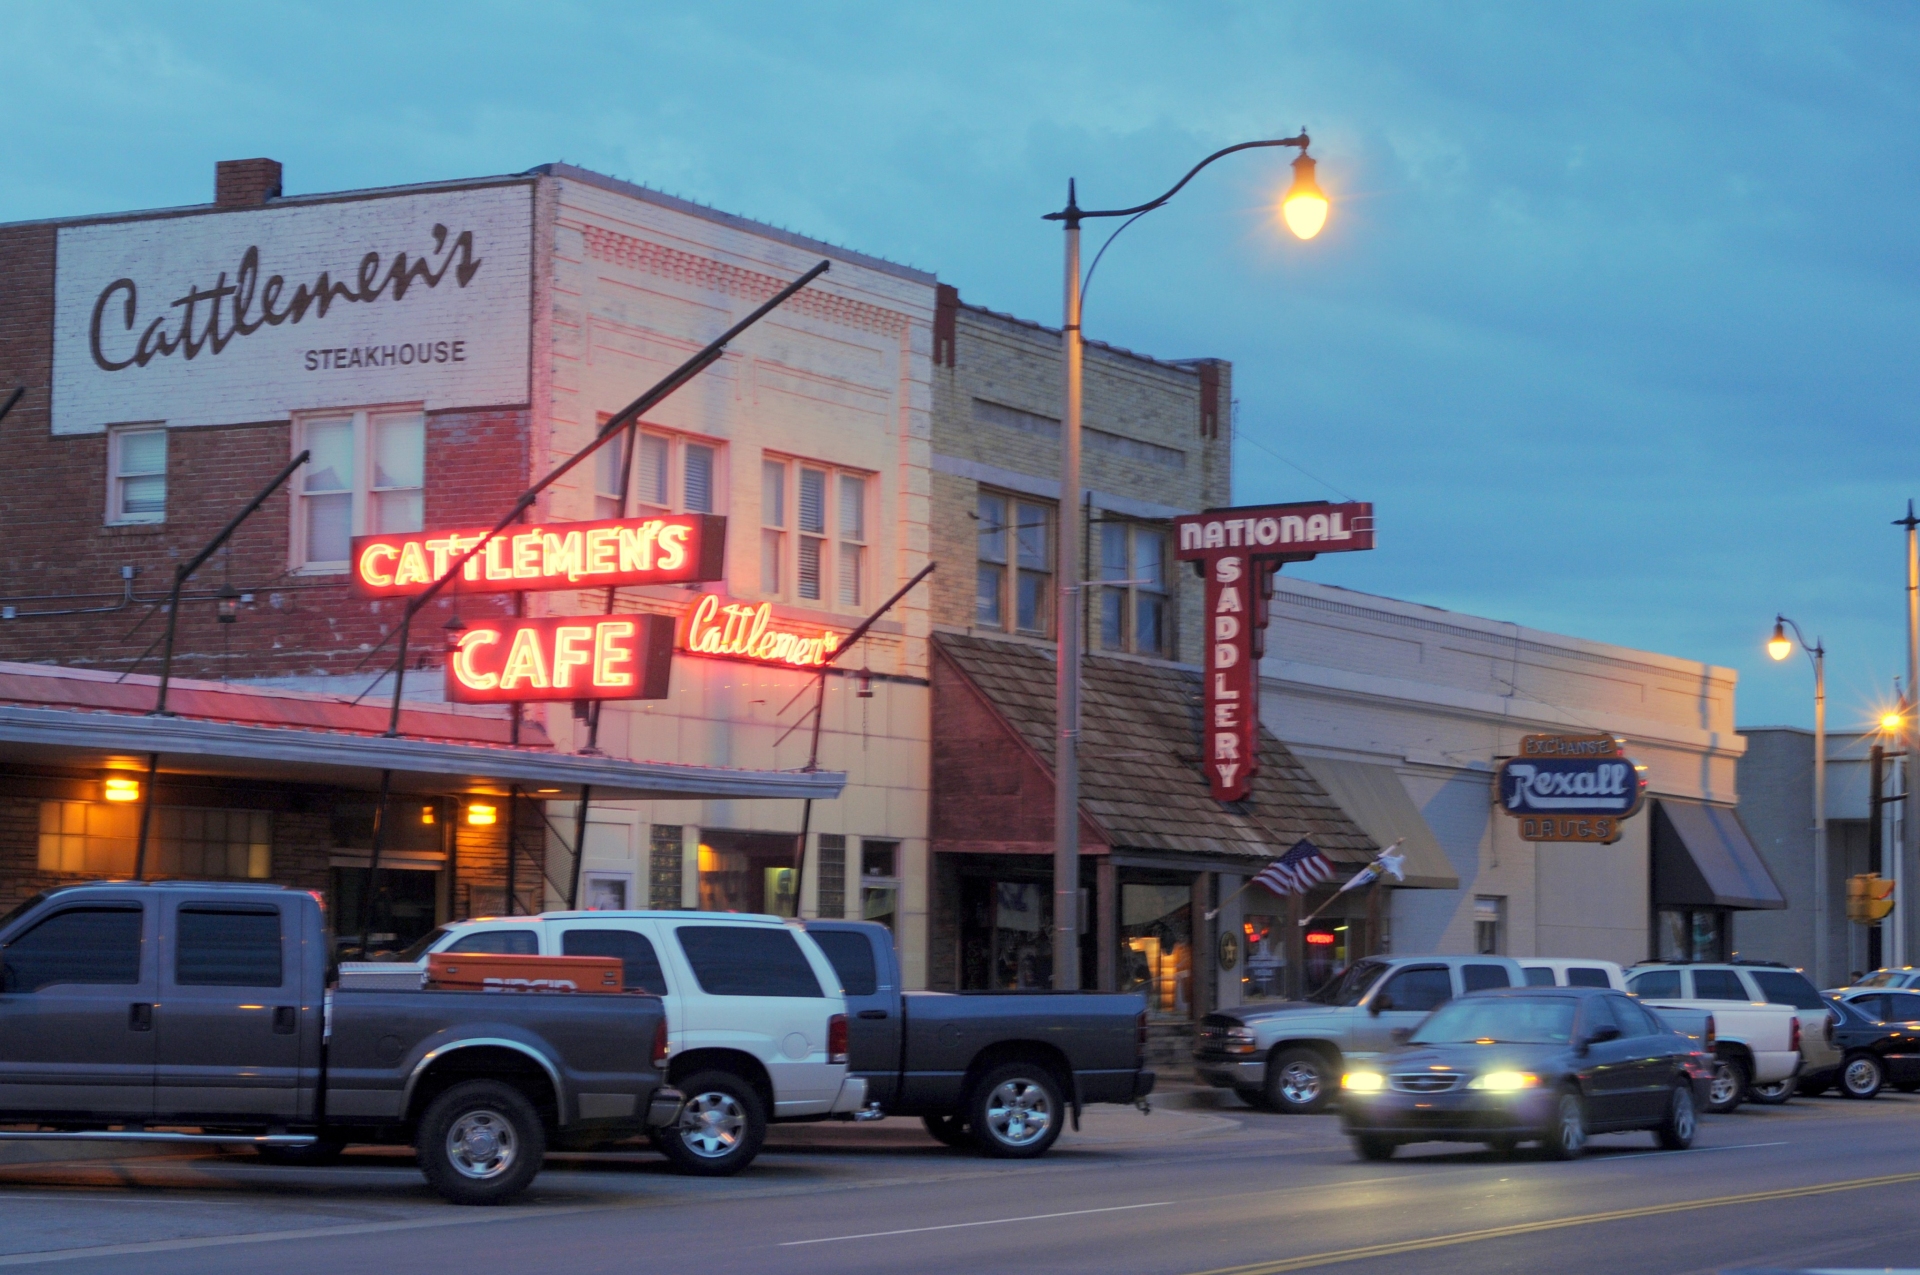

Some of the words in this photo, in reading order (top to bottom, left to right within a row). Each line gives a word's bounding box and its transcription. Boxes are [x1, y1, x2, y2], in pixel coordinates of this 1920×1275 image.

[90, 223, 481, 371] Cattlemen's
[305, 340, 465, 370] STEAKHOUSE
[359, 520, 692, 586] CATTLEMEN'S
[1180, 512, 1352, 550] NATIONAL
[453, 621, 634, 690] CAFE
[1214, 556, 1242, 788] SADDLERY
[1508, 763, 1629, 809] Rexall
[1524, 820, 1610, 838] DRUGS
[1306, 933, 1334, 944] OPEN
